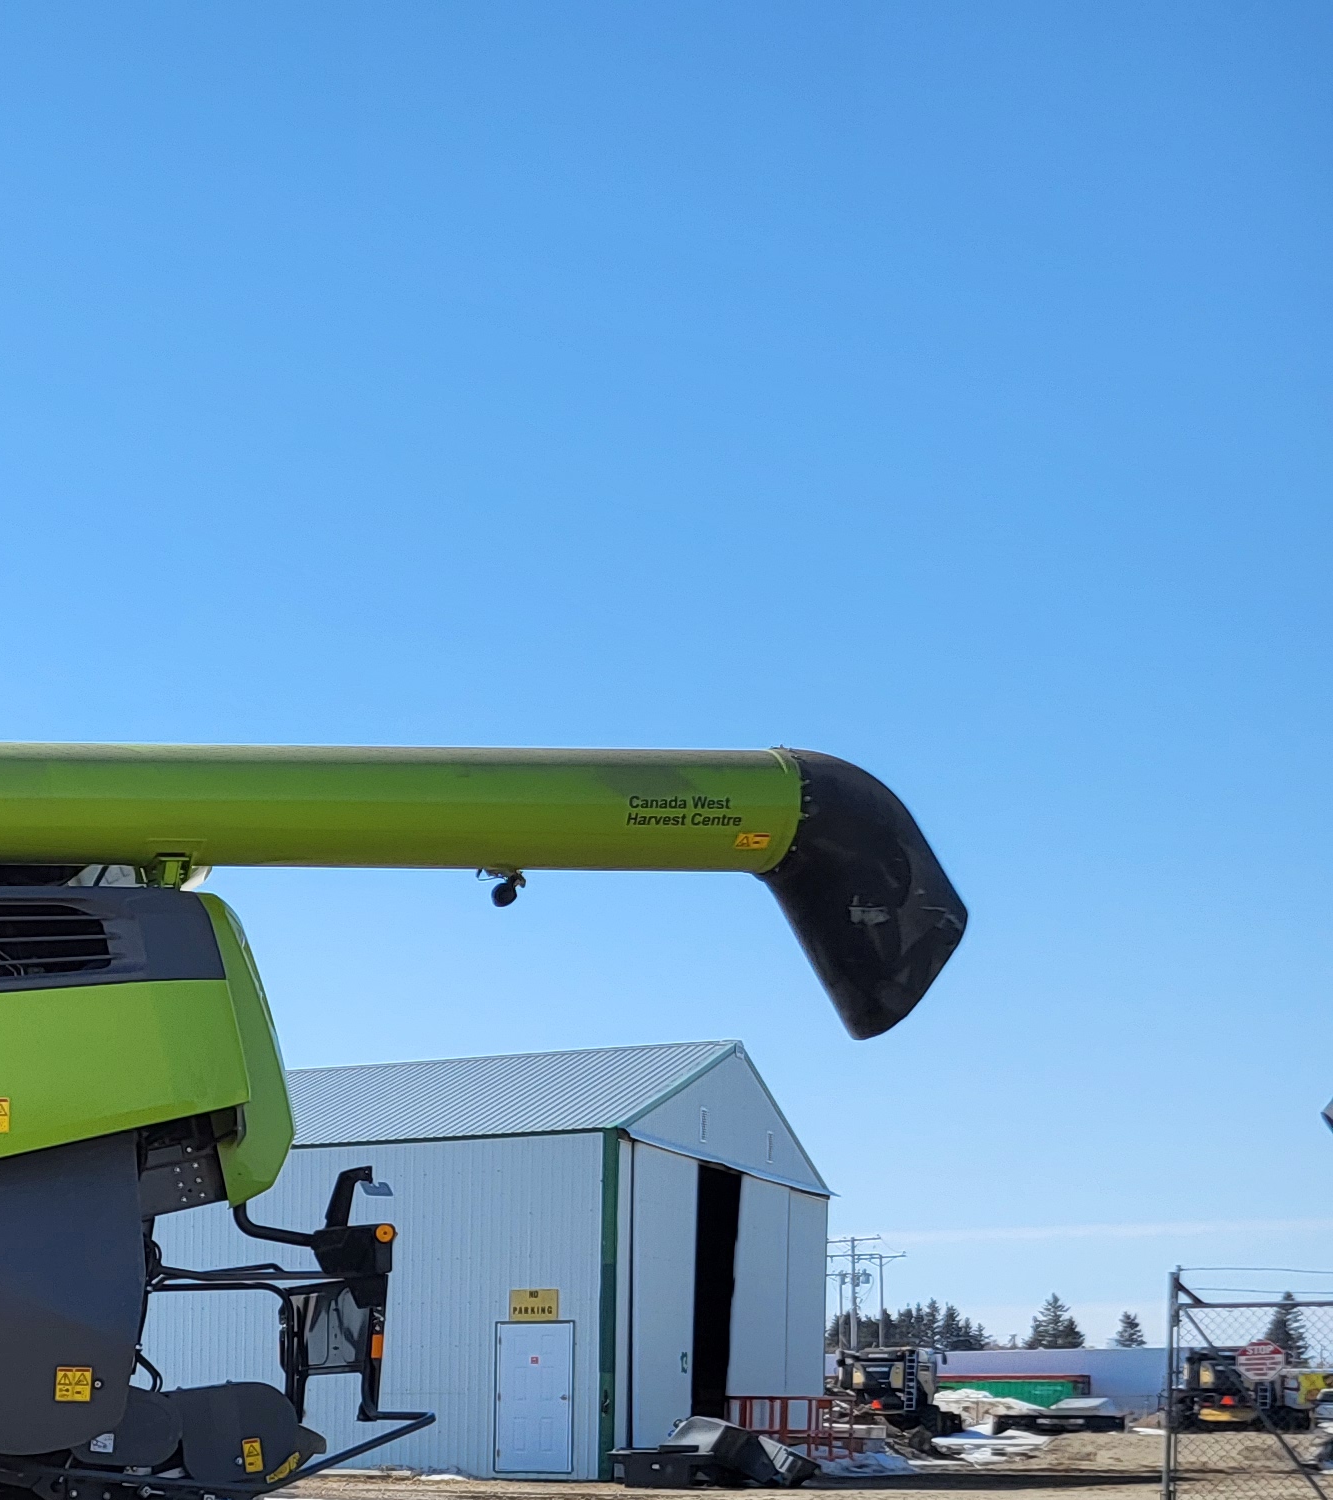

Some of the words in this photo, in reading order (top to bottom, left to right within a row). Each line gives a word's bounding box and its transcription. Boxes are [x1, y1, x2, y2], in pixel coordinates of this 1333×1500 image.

[628, 796, 687, 809] Canada
[691, 796, 732, 809] West
[626, 812, 687, 826] Harvest
[690, 813, 742, 826] Centre
[528, 1290, 539, 1298] NO
[512, 1306, 553, 1314] PARKING
[1246, 1345, 1274, 1354] STOP
